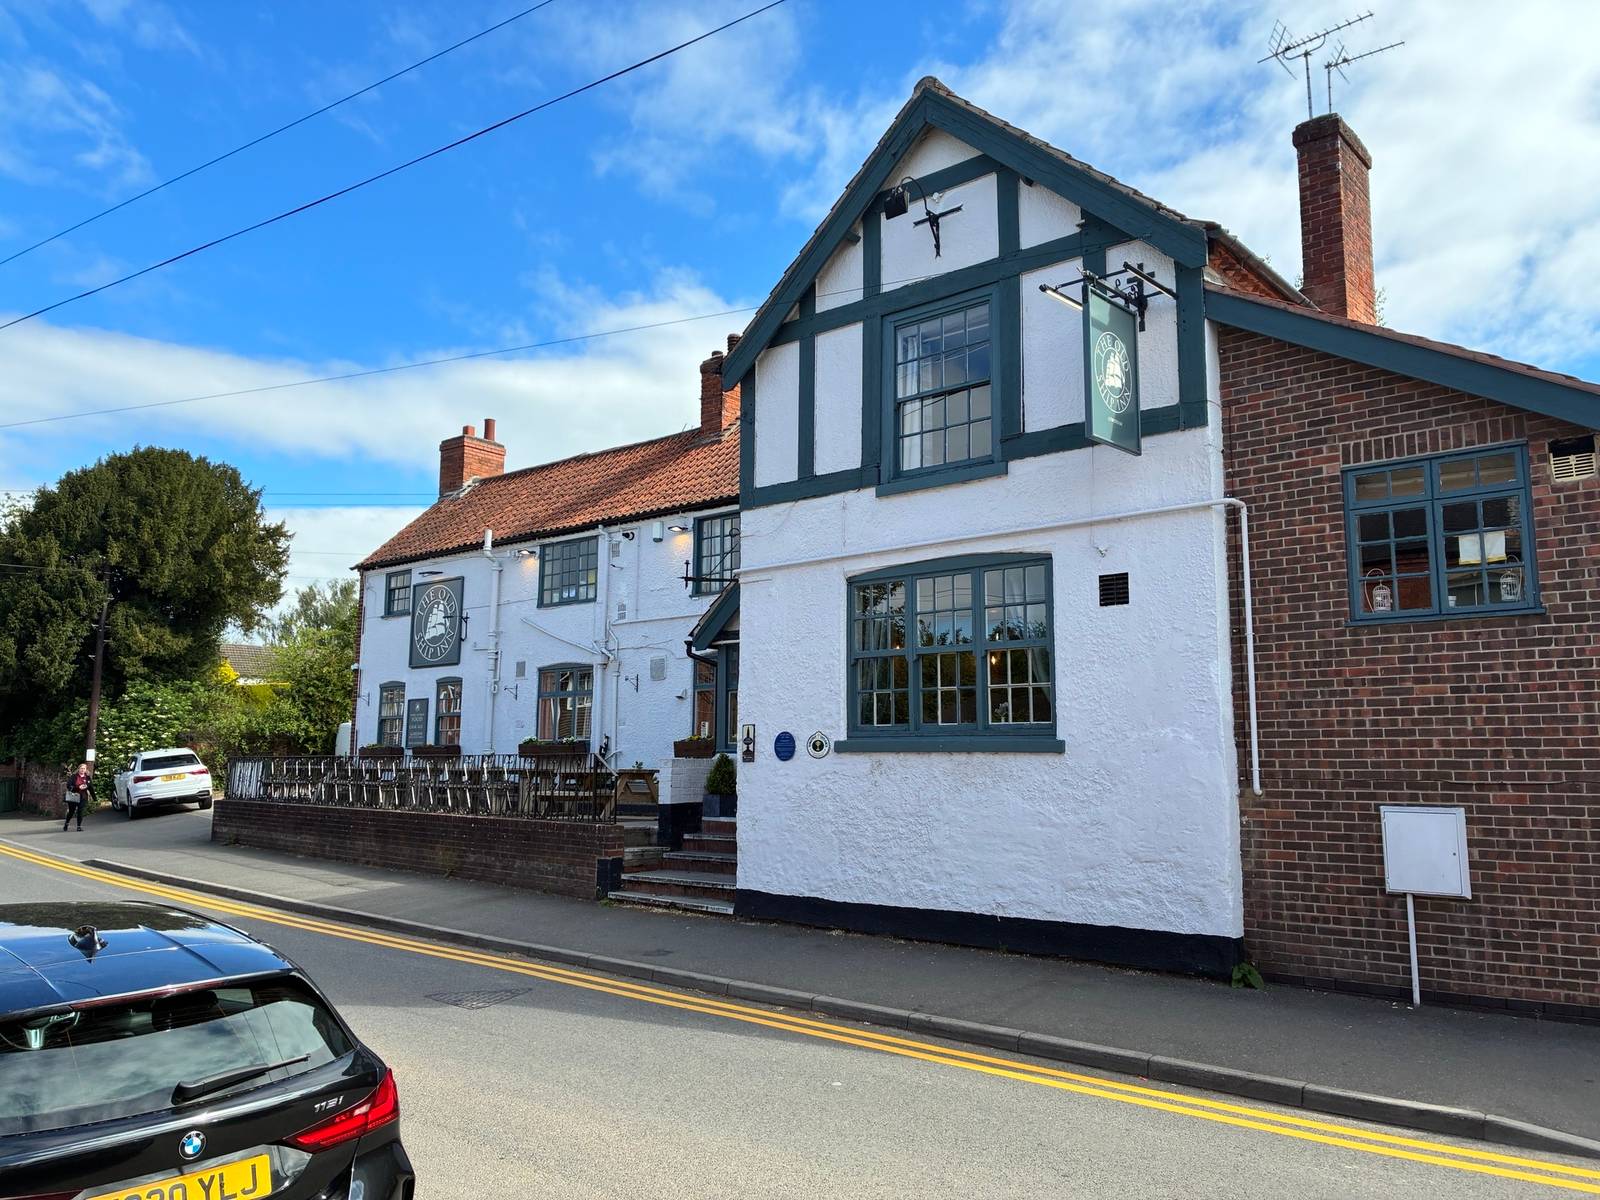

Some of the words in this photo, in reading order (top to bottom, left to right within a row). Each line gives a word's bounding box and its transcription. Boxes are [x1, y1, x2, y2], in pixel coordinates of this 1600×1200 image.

[1096, 334, 1112, 357] THE
[1114, 340, 1129, 372] OLD
[1097, 374, 1115, 409] SHIP
[1116, 386, 1131, 411] INN
[417, 590, 436, 616] THE
[438, 588, 456, 614] OLD
[415, 632, 434, 659] SHIP
[436, 629, 455, 658] INN
[197, 1164, 257, 1200] YLJ
